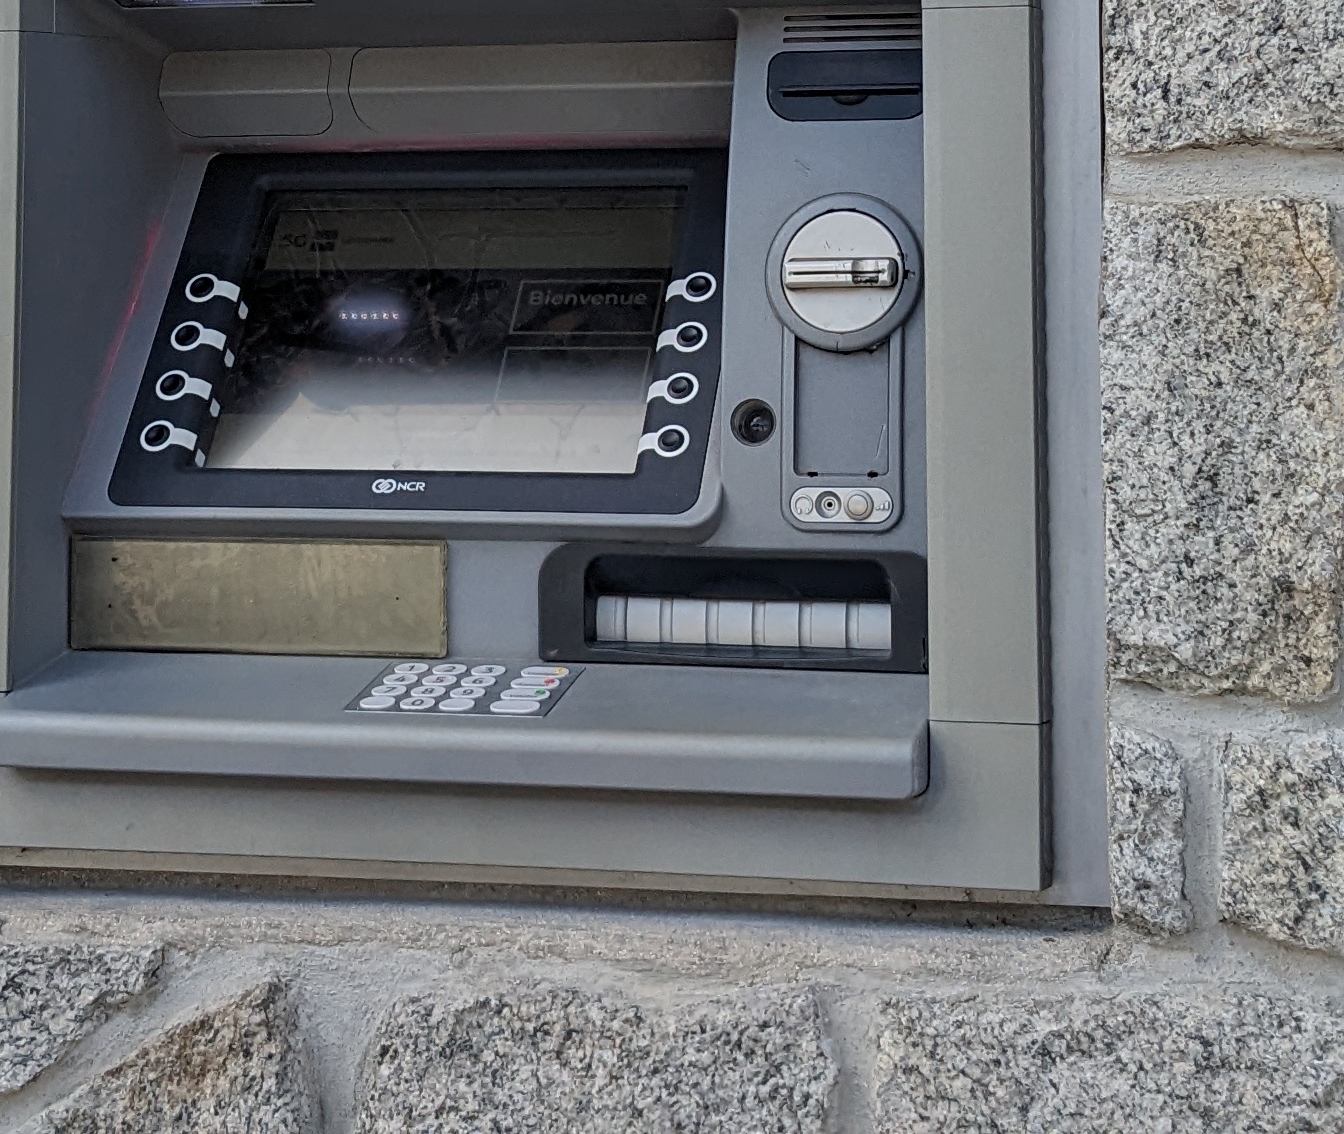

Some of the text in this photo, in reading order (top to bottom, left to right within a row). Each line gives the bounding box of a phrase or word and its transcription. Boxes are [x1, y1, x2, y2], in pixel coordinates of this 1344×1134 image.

[529, 289, 647, 306] Bienvenue
[397, 482, 426, 491] NCR
[484, 666, 494, 674] 3
